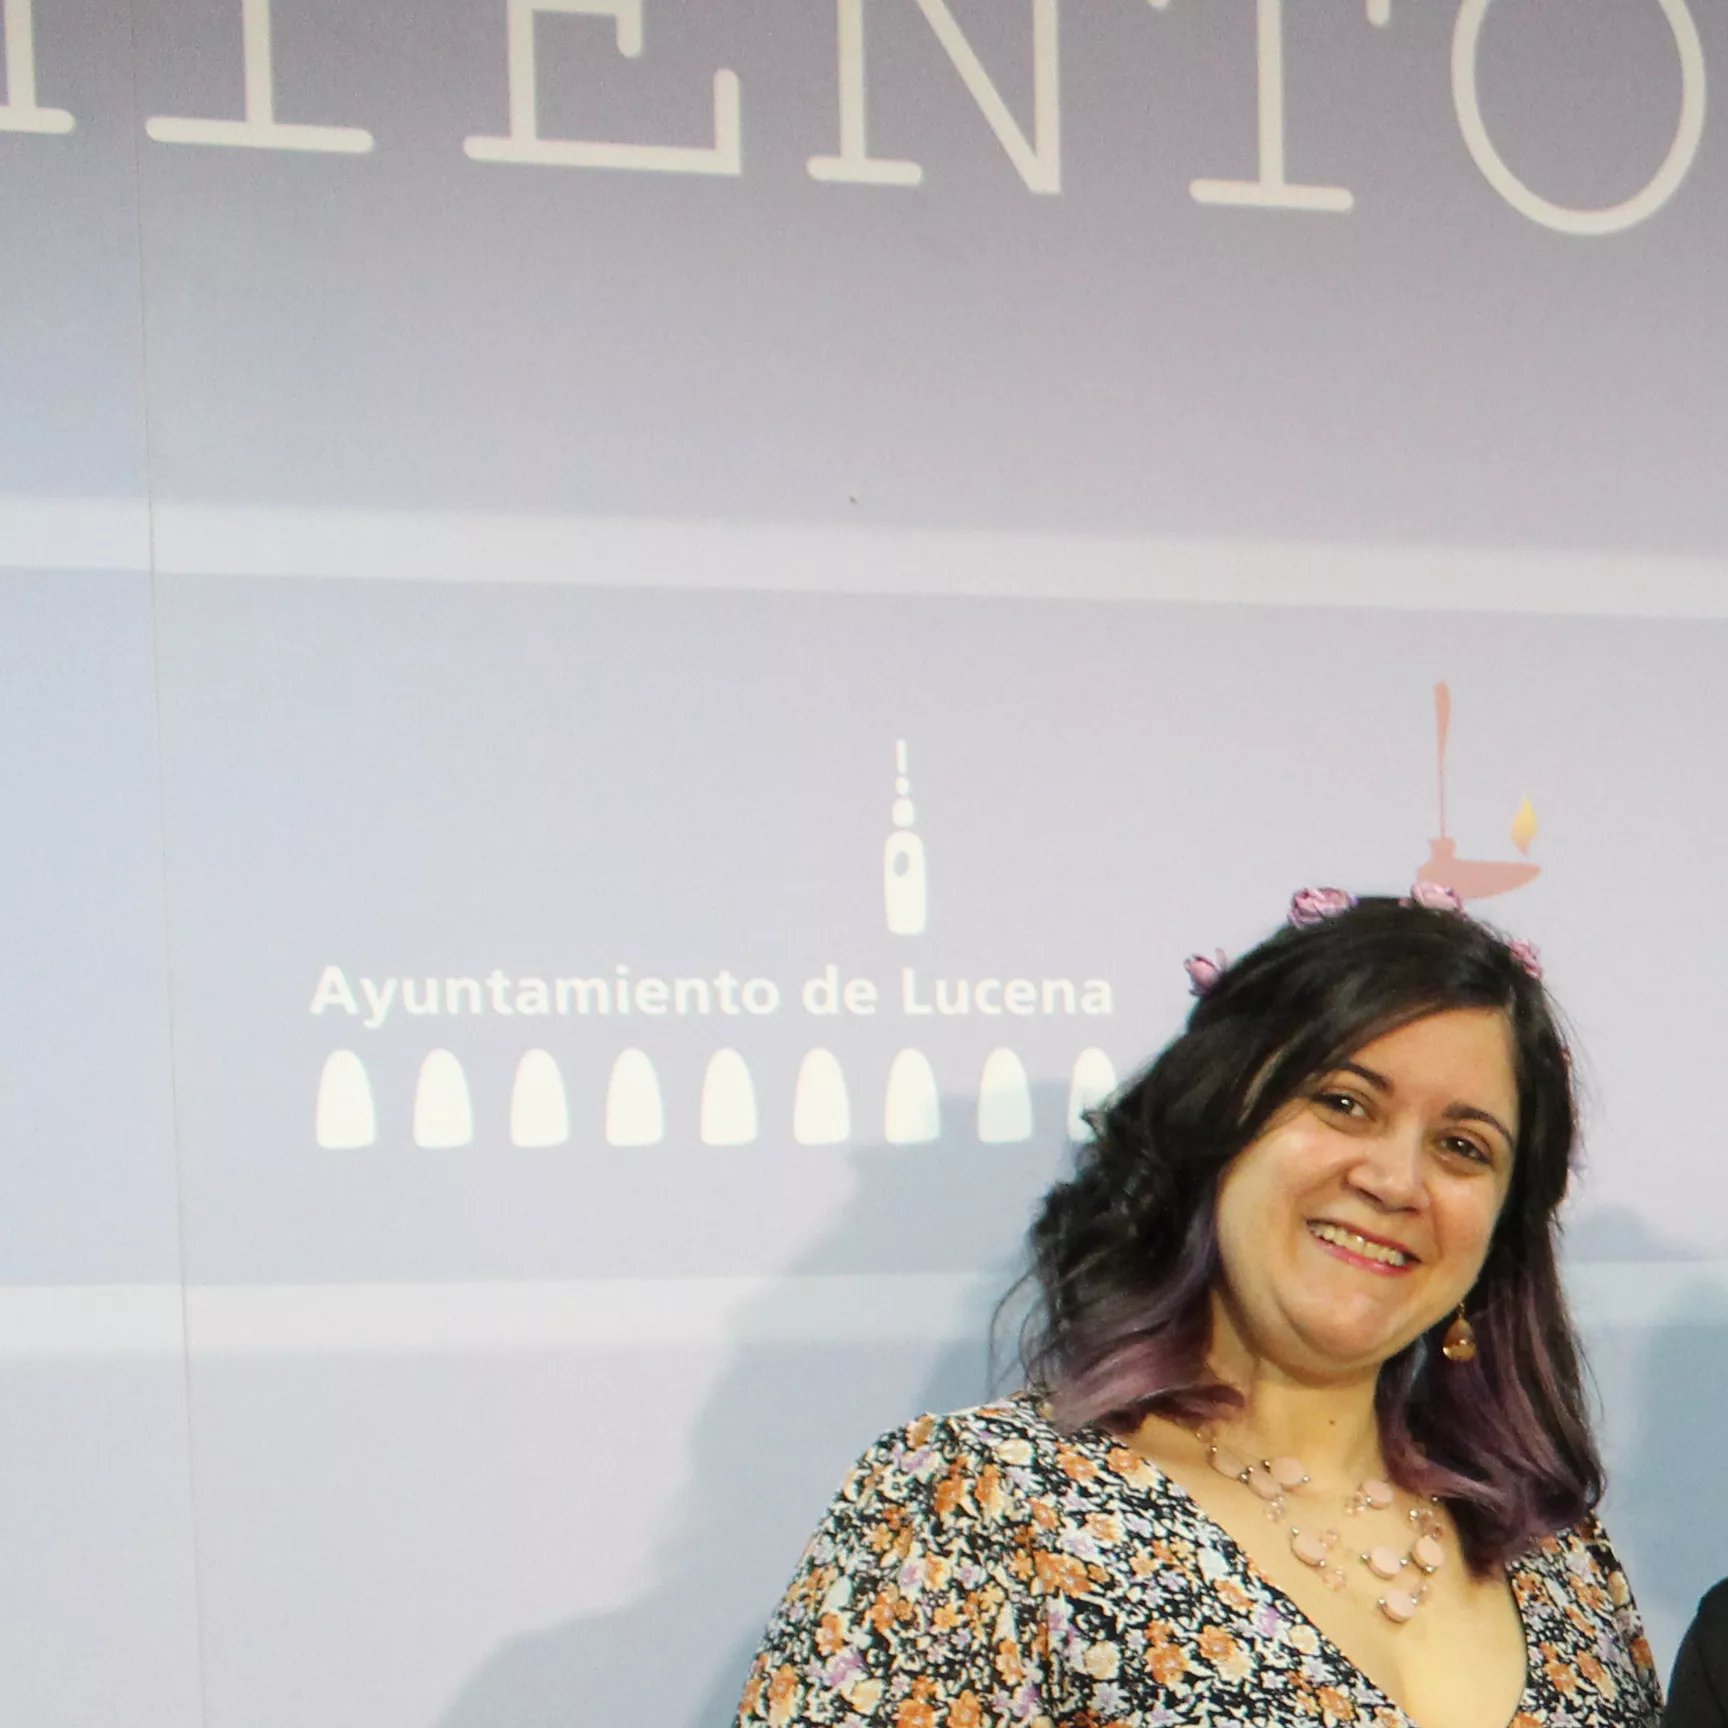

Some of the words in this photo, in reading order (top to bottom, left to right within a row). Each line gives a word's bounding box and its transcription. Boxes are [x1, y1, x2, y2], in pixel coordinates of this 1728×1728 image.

[308, 963, 779, 1030] Ayuntamiento
[802, 962, 878, 1015] de
[903, 967, 1114, 1015] Lucena
